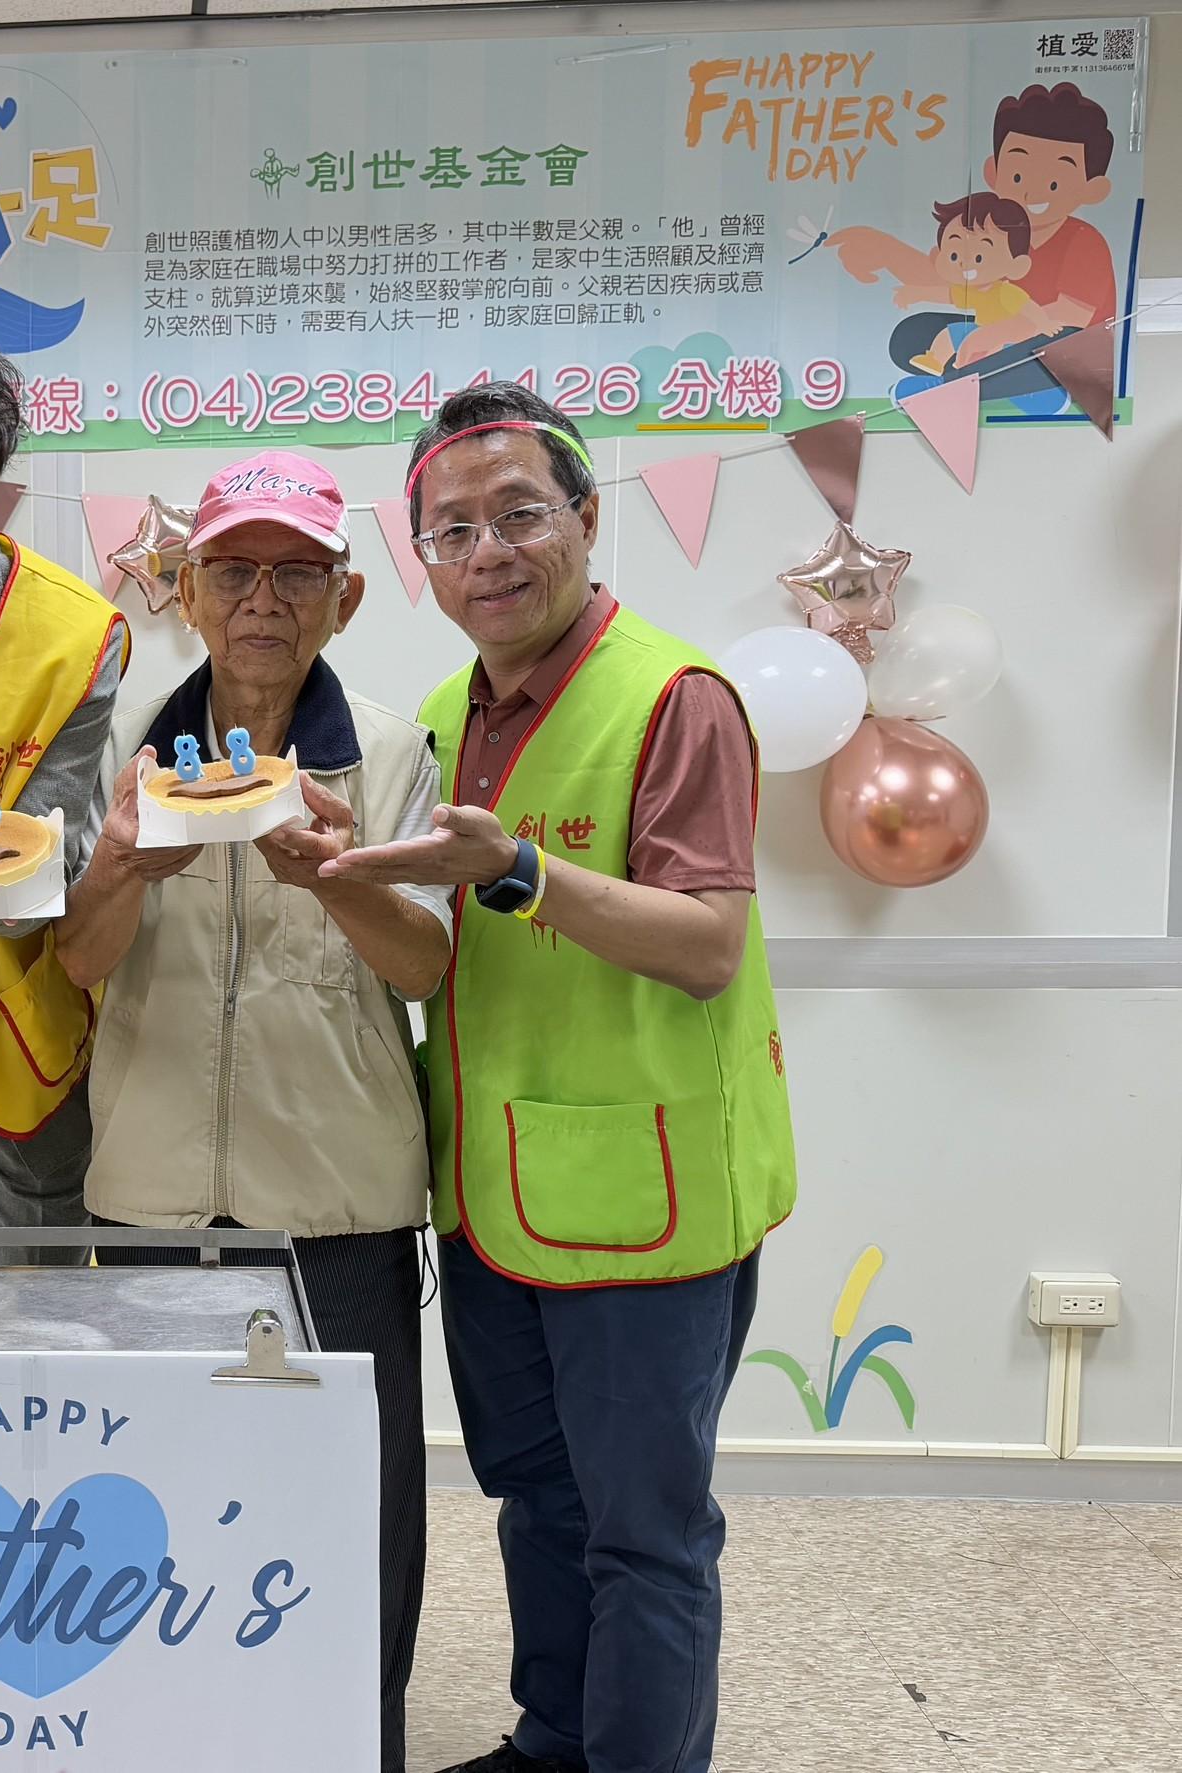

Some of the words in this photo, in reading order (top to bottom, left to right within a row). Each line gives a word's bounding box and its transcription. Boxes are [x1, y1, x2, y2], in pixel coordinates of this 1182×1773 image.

[1037, 32, 1098, 58] 植愛
[743, 51, 875, 91] HAPPY
[685, 58, 948, 183] FATHER'S
[306, 143, 590, 193] 創世基金會
[785, 144, 870, 184] DAY
[662, 357, 780, 417] 分機
[803, 360, 844, 409] 9
